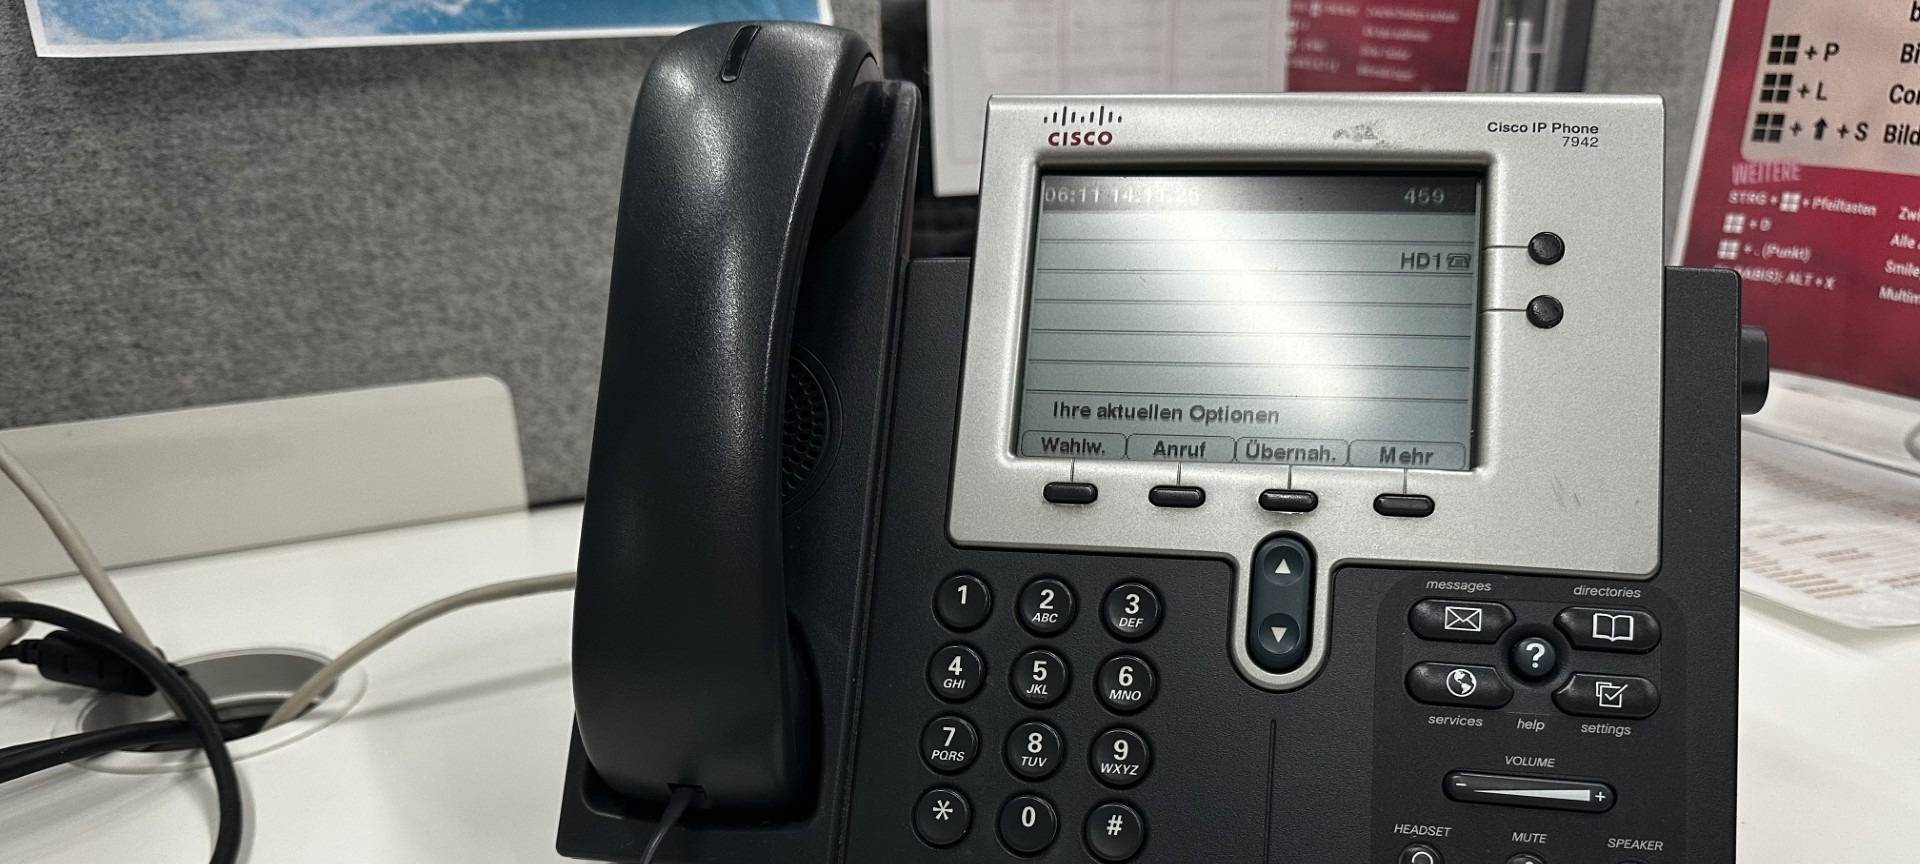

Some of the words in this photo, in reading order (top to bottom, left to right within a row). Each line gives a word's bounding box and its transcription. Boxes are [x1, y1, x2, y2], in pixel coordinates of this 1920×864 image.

[1823, 42, 1840, 61] P
[1816, 82, 1828, 101] L
[1487, 122, 1528, 133] Cisco
[1532, 122, 1547, 133] IP
[1552, 122, 1599, 134] Phone
[1854, 121, 1869, 141] S
[1048, 131, 1113, 146] CISCO
[1562, 136, 1599, 148] 7942
[1045, 187, 1100, 203] 06:11
[1404, 187, 1445, 204] 459
[1728, 189, 1768, 206] STRG
[1812, 196, 1877, 217] Pfeiltasten
[1889, 233, 1916, 249] Alle
[1400, 252, 1441, 269] HD1
[1053, 401, 1091, 418] Ihre
[1097, 403, 1183, 422] aktuellen
[1189, 405, 1280, 426] Optionen
[1041, 437, 1105, 455] Wahlw.
[1153, 440, 1207, 458] Anruf
[1246, 439, 1336, 463] Übernah.
[1379, 446, 1435, 465] Mehr
[957, 584, 968, 605] 1
[1426, 580, 1491, 593] messages
[1573, 584, 1641, 599] directories
[1039, 589, 1055, 609] 2
[1125, 594, 1140, 614] 3
[1032, 613, 1058, 623] ABC
[1119, 617, 1144, 628] DEF
[948, 655, 963, 676] 4
[1033, 660, 1048, 681] 5
[943, 678, 966, 689] GHI
[1118, 665, 1133, 687] 6
[1026, 684, 1048, 695] JKL
[1109, 690, 1142, 701] MNO
[1428, 714, 1483, 727] services
[1517, 718, 1545, 733] help
[942, 726, 956, 747] 7
[1581, 722, 1632, 736] settings
[1027, 732, 1043, 753] 8
[1113, 739, 1129, 761] 9
[931, 749, 965, 762] PQRS
[1021, 756, 1047, 767] TUV
[1505, 755, 1555, 768] VOLUME
[1100, 762, 1139, 776] WXYZ
[1021, 805, 1036, 827] 0
[1106, 814, 1123, 836] #
[1394, 823, 1452, 837] HEADSET
[1512, 832, 1547, 844] MUTE
[1606, 838, 1664, 851] SPEAKER
